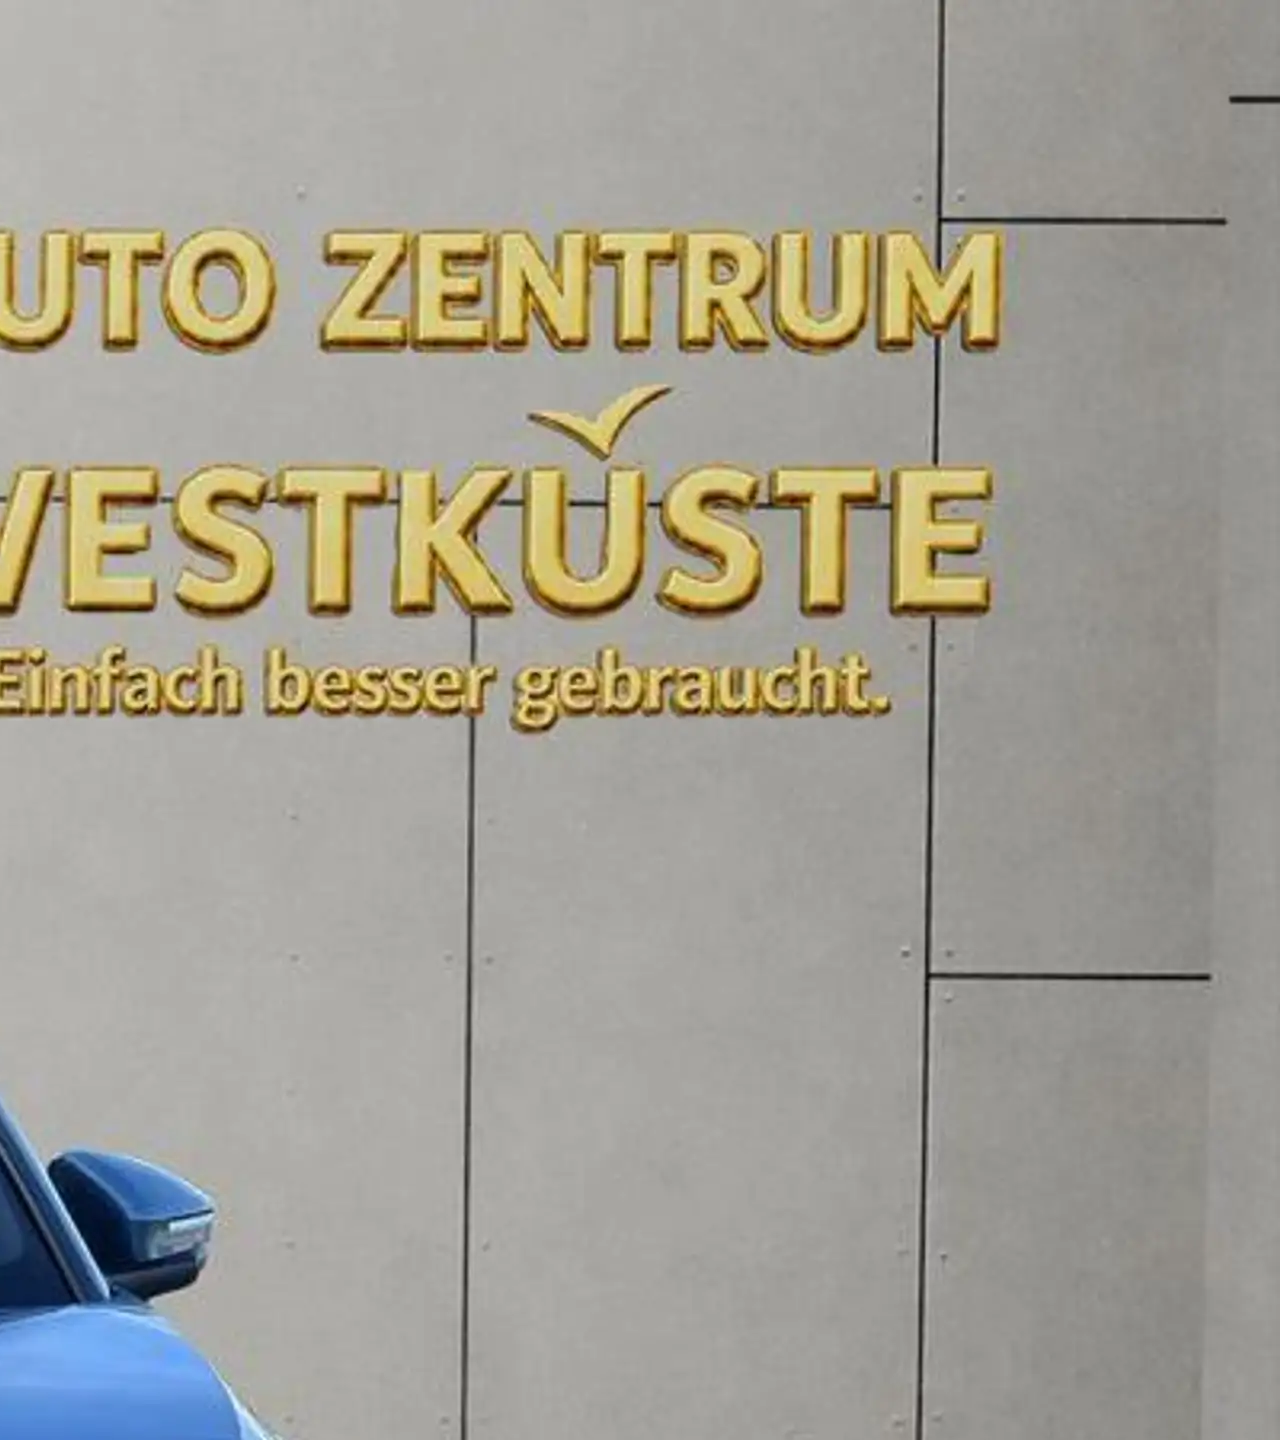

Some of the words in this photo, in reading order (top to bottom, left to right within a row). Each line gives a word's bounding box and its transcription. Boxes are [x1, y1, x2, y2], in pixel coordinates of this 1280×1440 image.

[318, 228, 1005, 353] ZENTRUM
[265, 645, 496, 716] besser
[510, 645, 892, 732] gebraucht.
